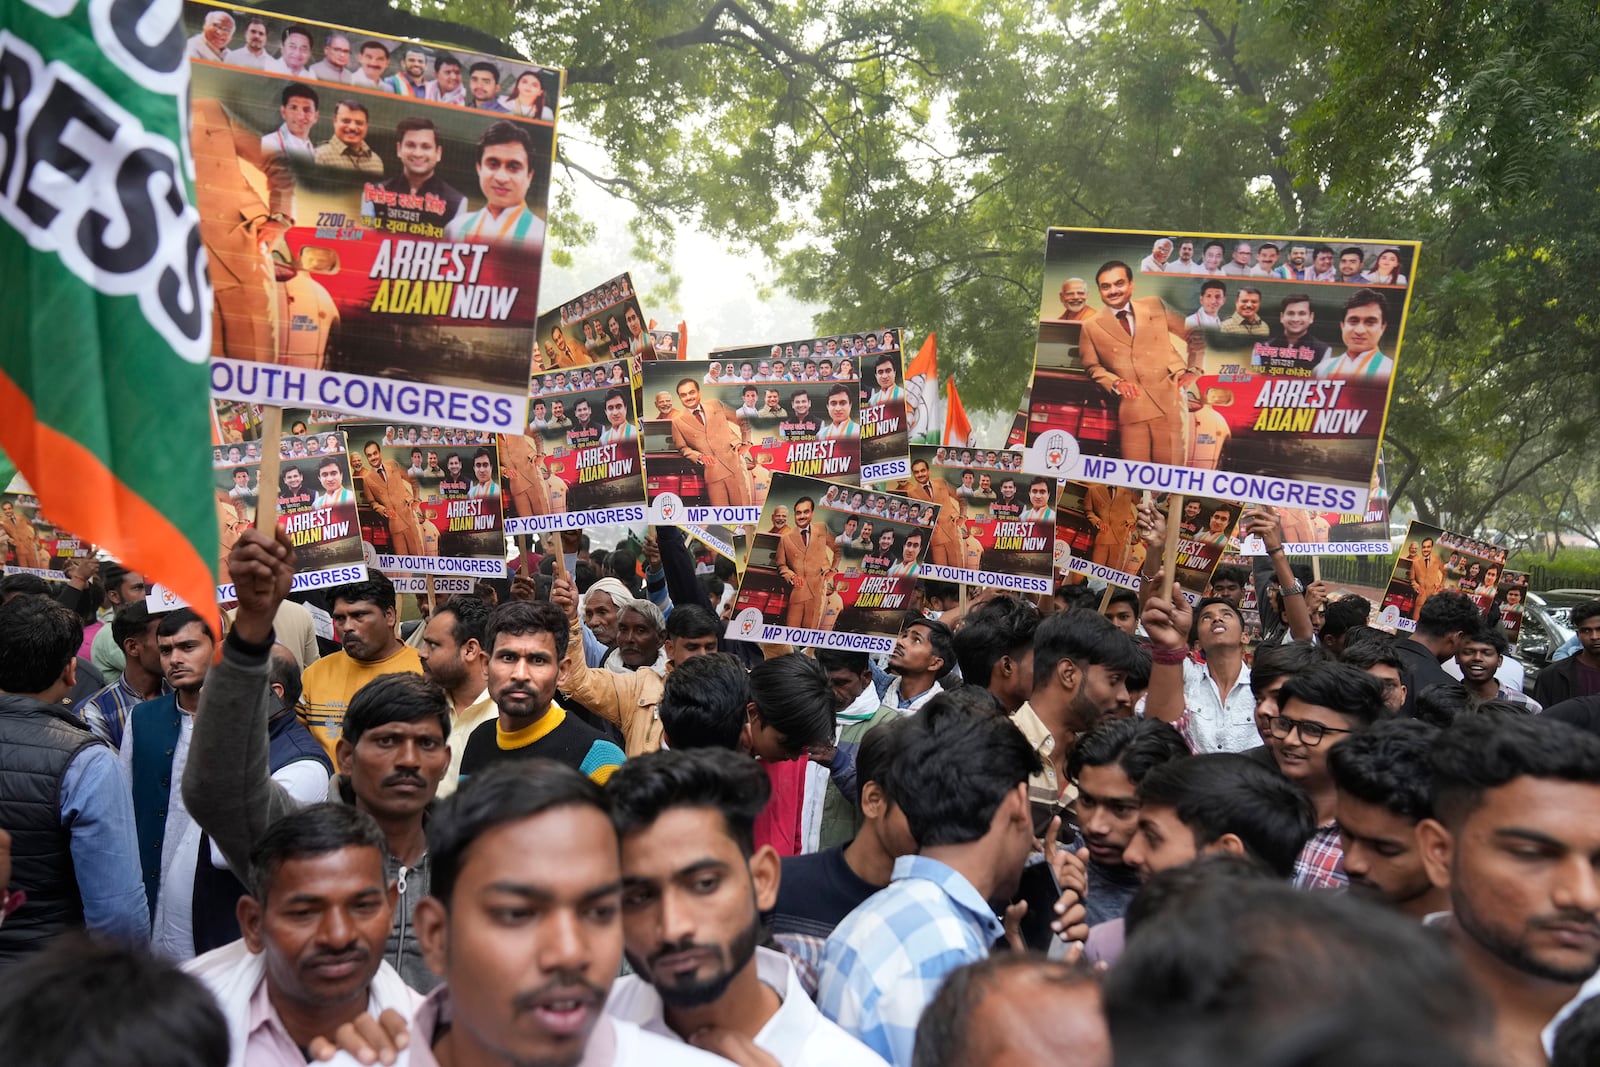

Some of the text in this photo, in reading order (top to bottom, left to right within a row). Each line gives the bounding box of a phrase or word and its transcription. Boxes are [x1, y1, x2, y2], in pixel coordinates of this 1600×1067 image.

[316, 212, 346, 228] 2200
[369, 238, 489, 283] ARREST
[371, 279, 519, 321] ADANI NOW
[319, 375, 512, 427] CONGRESS
[1254, 380, 1346, 409] ARREST
[876, 416, 899, 437] NOW
[1254, 408, 1368, 434] ADANI NOW
[576, 443, 617, 470] ARREST
[786, 440, 836, 463] ARREST
[579, 458, 633, 484] ADANI NOW
[788, 456, 852, 475] ADANI NOW
[863, 461, 906, 479] GRESS
[1083, 457, 1357, 511] MP YOUTH CONGRESS
[447, 500, 482, 518] ARREST
[521, 515, 563, 532] YOUTH
[567, 507, 643, 527] CONGRESS
[687, 508, 709, 522] MP
[285, 507, 332, 535] ARREST
[449, 514, 495, 533] ADANI NOW
[993, 521, 1035, 538] ARREST
[290, 520, 349, 547] ADANI NOW
[701, 530, 736, 558] CONGRES
[994, 537, 1047, 551] ADANI NOW
[1288, 543, 1389, 553] YOUTH CONGRESS
[380, 555, 502, 573] MP YOUTH CONGRESS
[1069, 558, 1088, 572] MP
[1090, 563, 1131, 586] YOUTH
[1185, 556, 1212, 570] NOW
[410, 580, 470, 591] COGRESS
[857, 576, 899, 594] ARREST
[935, 566, 974, 583] YOUTH
[977, 573, 1047, 592] CONGRESS
[854, 593, 905, 609] ADANI NOW
[761, 625, 892, 652] MP YOUTH CONGRESS
